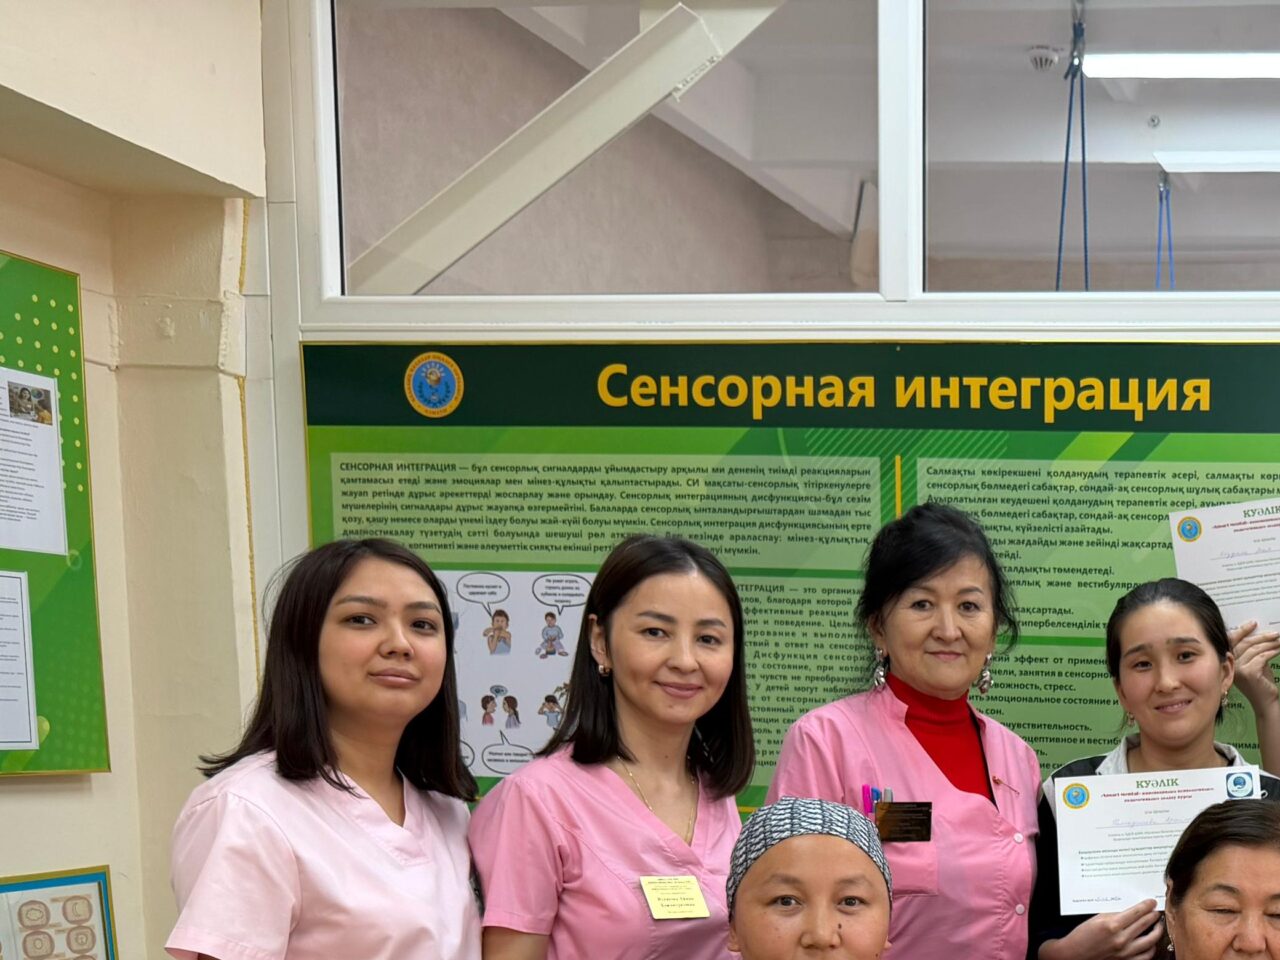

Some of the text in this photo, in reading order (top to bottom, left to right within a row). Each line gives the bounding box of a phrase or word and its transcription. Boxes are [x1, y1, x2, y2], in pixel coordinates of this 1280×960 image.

[597, 365, 1211, 423] Сенсорная интеграция
[338, 461, 394, 471] СЕНСОРНАЯ
[395, 462, 457, 472] ИНТЕГРАЦИЯ
[470, 463, 488, 474] бұл
[489, 464, 540, 474] сенсорлық
[541, 465, 602, 474] сигналдарды
[603, 464, 668, 475] ұйымдастыру
[670, 466, 709, 475] арқылы
[726, 465, 766, 476] дененің
[767, 465, 798, 476] тиімді
[799, 467, 871, 478] реакцияларын
[925, 466, 976, 477] Салмақты
[980, 466, 1042, 478] көкірекшені
[1045, 470, 1109, 480] қолданудың
[1113, 471, 1166, 480] терапевтік
[1170, 469, 1200, 482] әсері,
[1204, 472, 1255, 481] салмақты
[1136, 778, 1179, 789] КУӘЛІК
